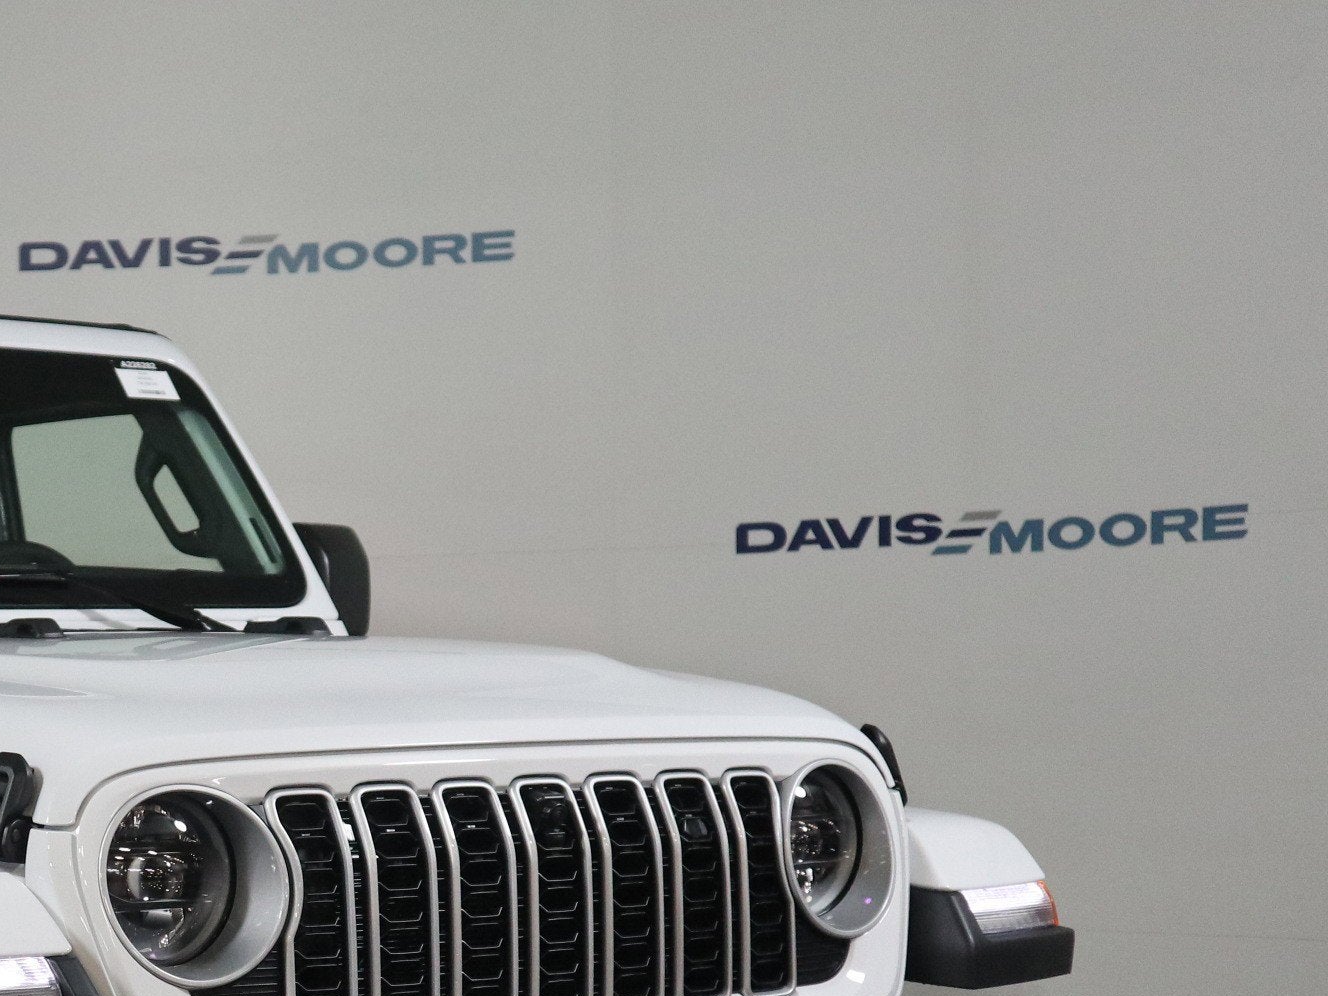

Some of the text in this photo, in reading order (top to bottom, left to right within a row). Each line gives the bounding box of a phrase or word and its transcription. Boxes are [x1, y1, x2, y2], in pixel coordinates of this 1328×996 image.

[18, 229, 516, 275] DAVIS MOORE
[735, 503, 1249, 555] DAVIS MOORE
